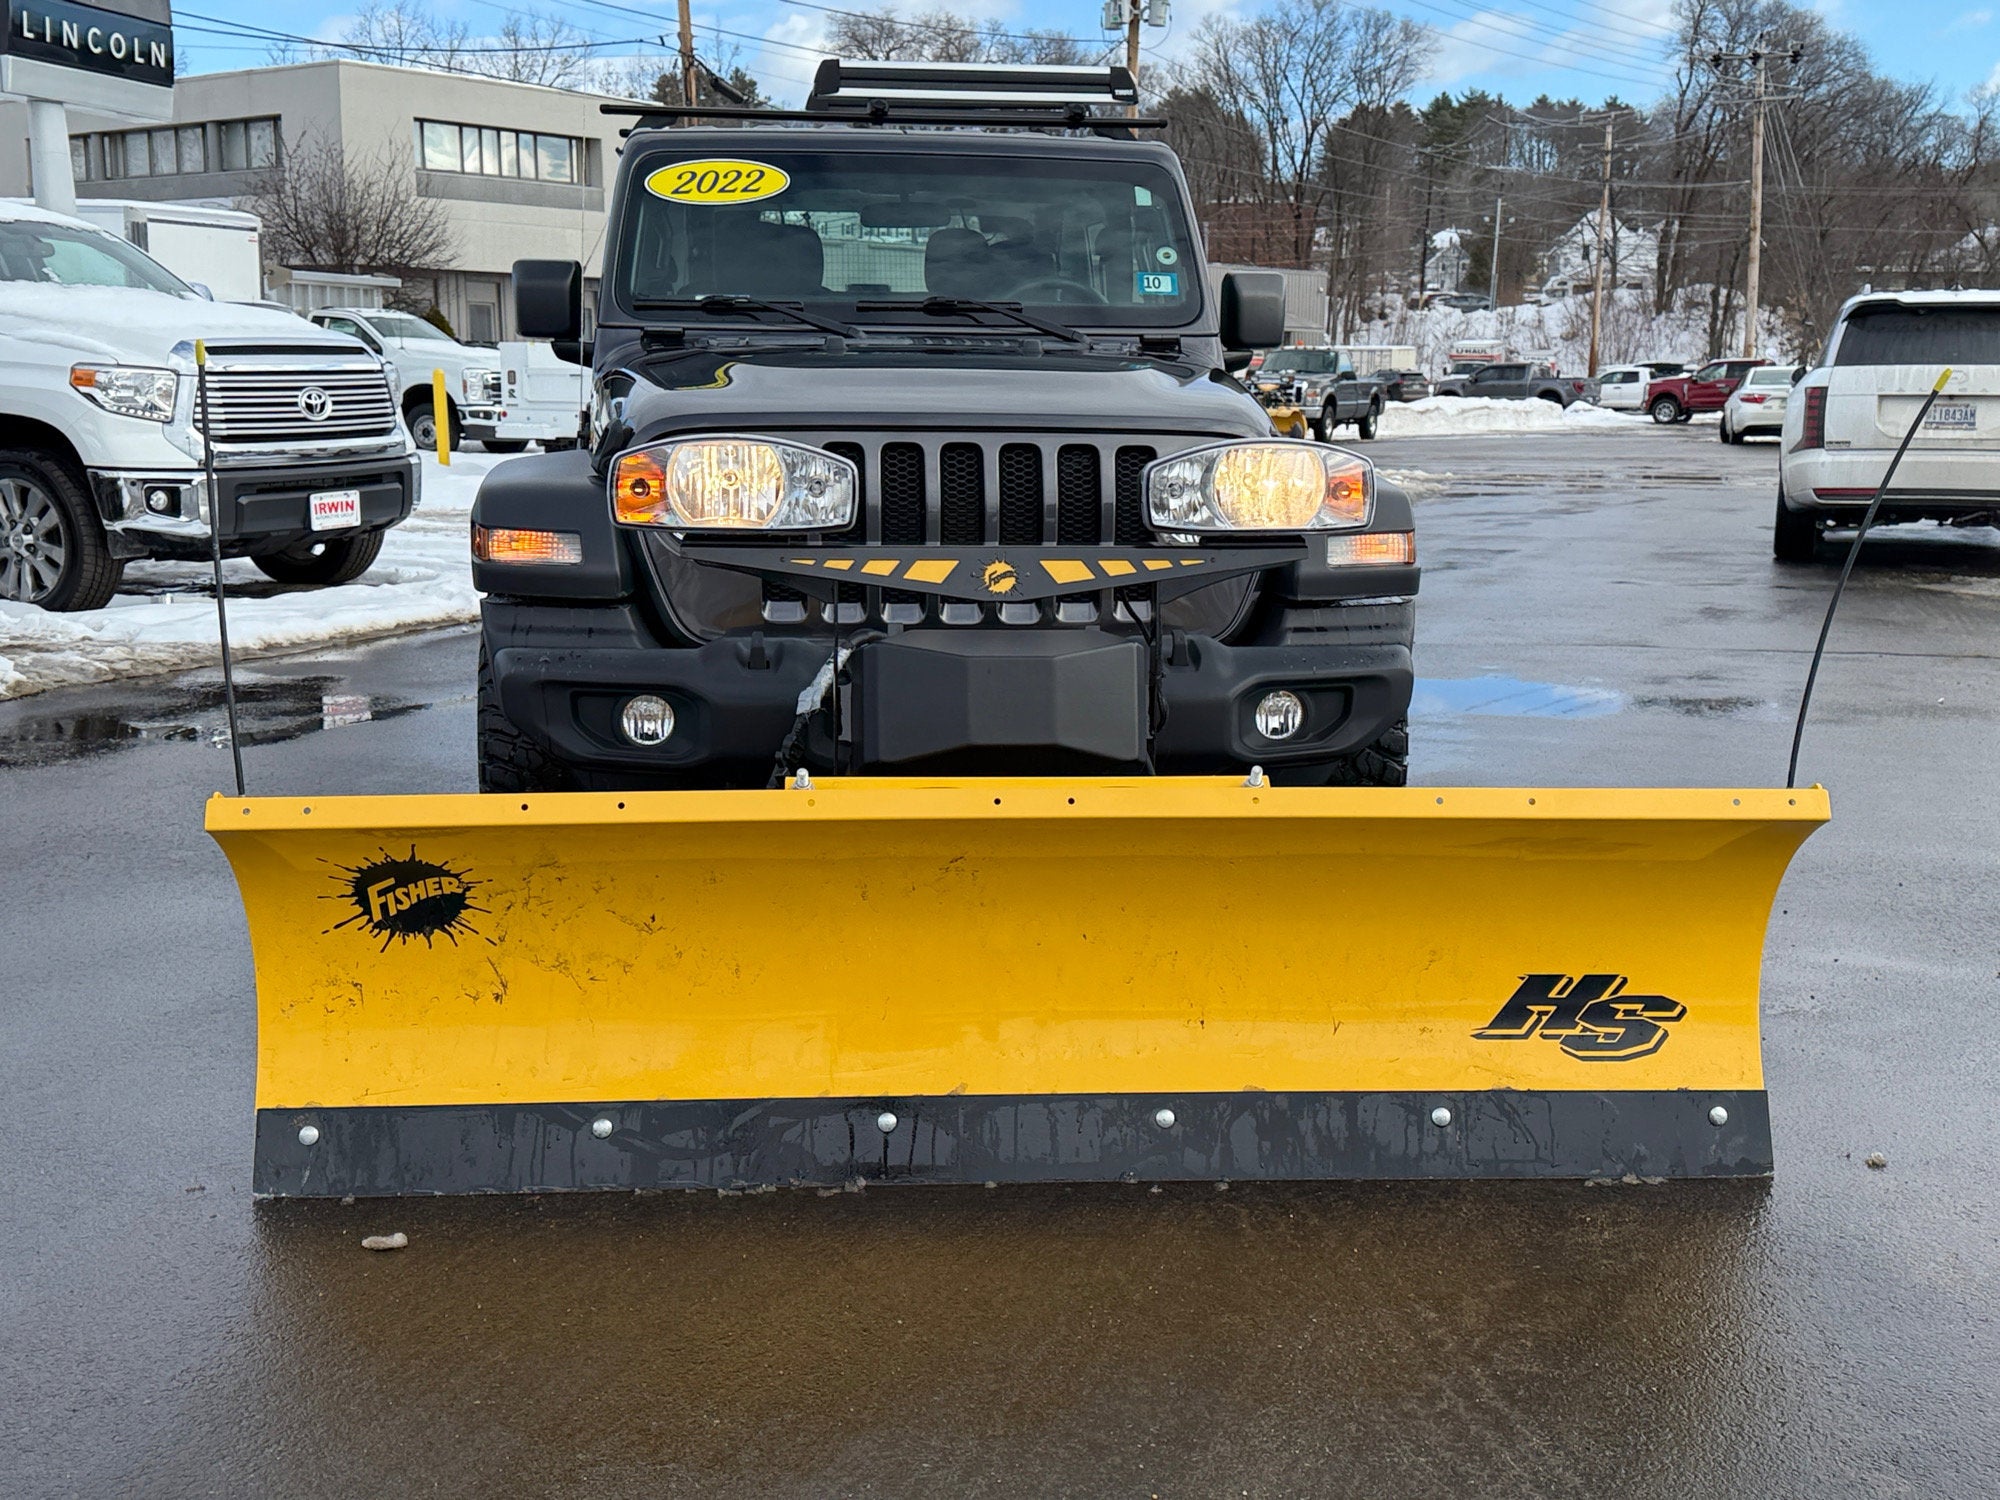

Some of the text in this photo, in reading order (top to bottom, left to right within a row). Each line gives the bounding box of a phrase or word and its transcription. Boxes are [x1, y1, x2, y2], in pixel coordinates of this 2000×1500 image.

[22, 10, 166, 68] LINCOLN
[670, 169, 765, 194] 2022
[1144, 276, 1161, 289] 10
[314, 500, 354, 515] IRWIN
[367, 876, 464, 923] FISHER
[1470, 974, 1687, 1061] HS
